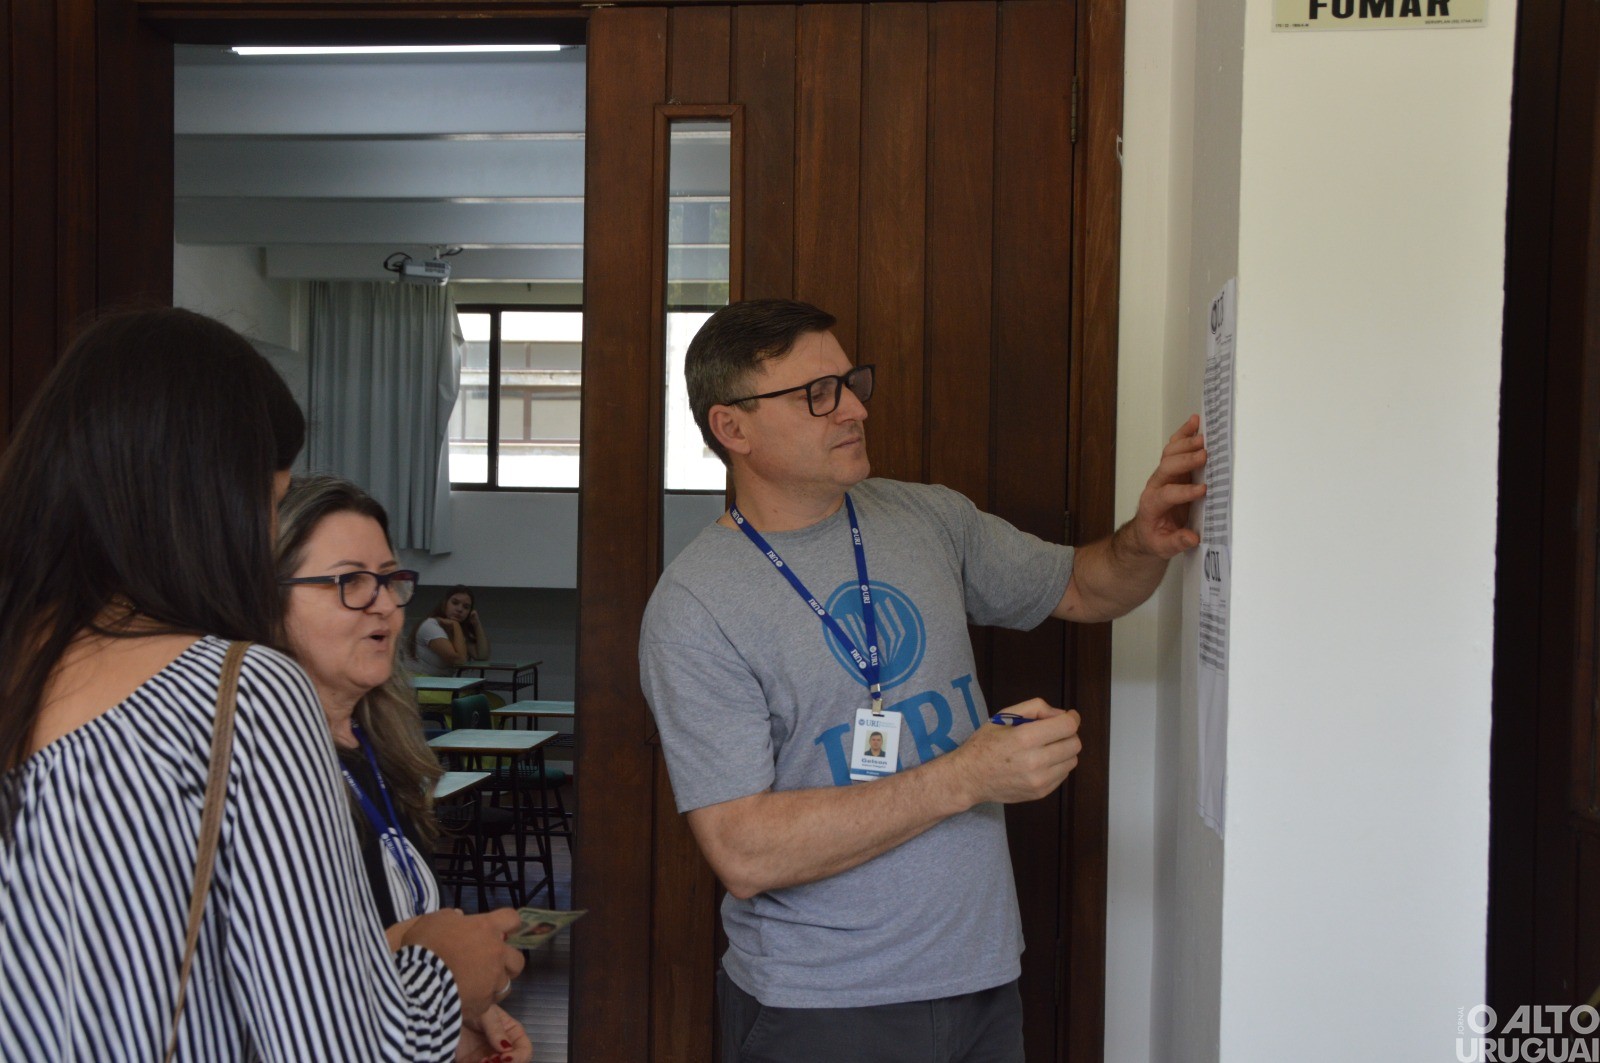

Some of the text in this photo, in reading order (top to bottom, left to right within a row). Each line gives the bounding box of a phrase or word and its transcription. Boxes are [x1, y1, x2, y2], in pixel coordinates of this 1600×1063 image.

[1308, 0, 1450, 19] FUMAR
[767, 551, 779, 562] URI
[863, 592, 871, 604] URI
[808, 599, 820, 611] URI
[851, 649, 863, 663] URI
[866, 719, 880, 727] URI
